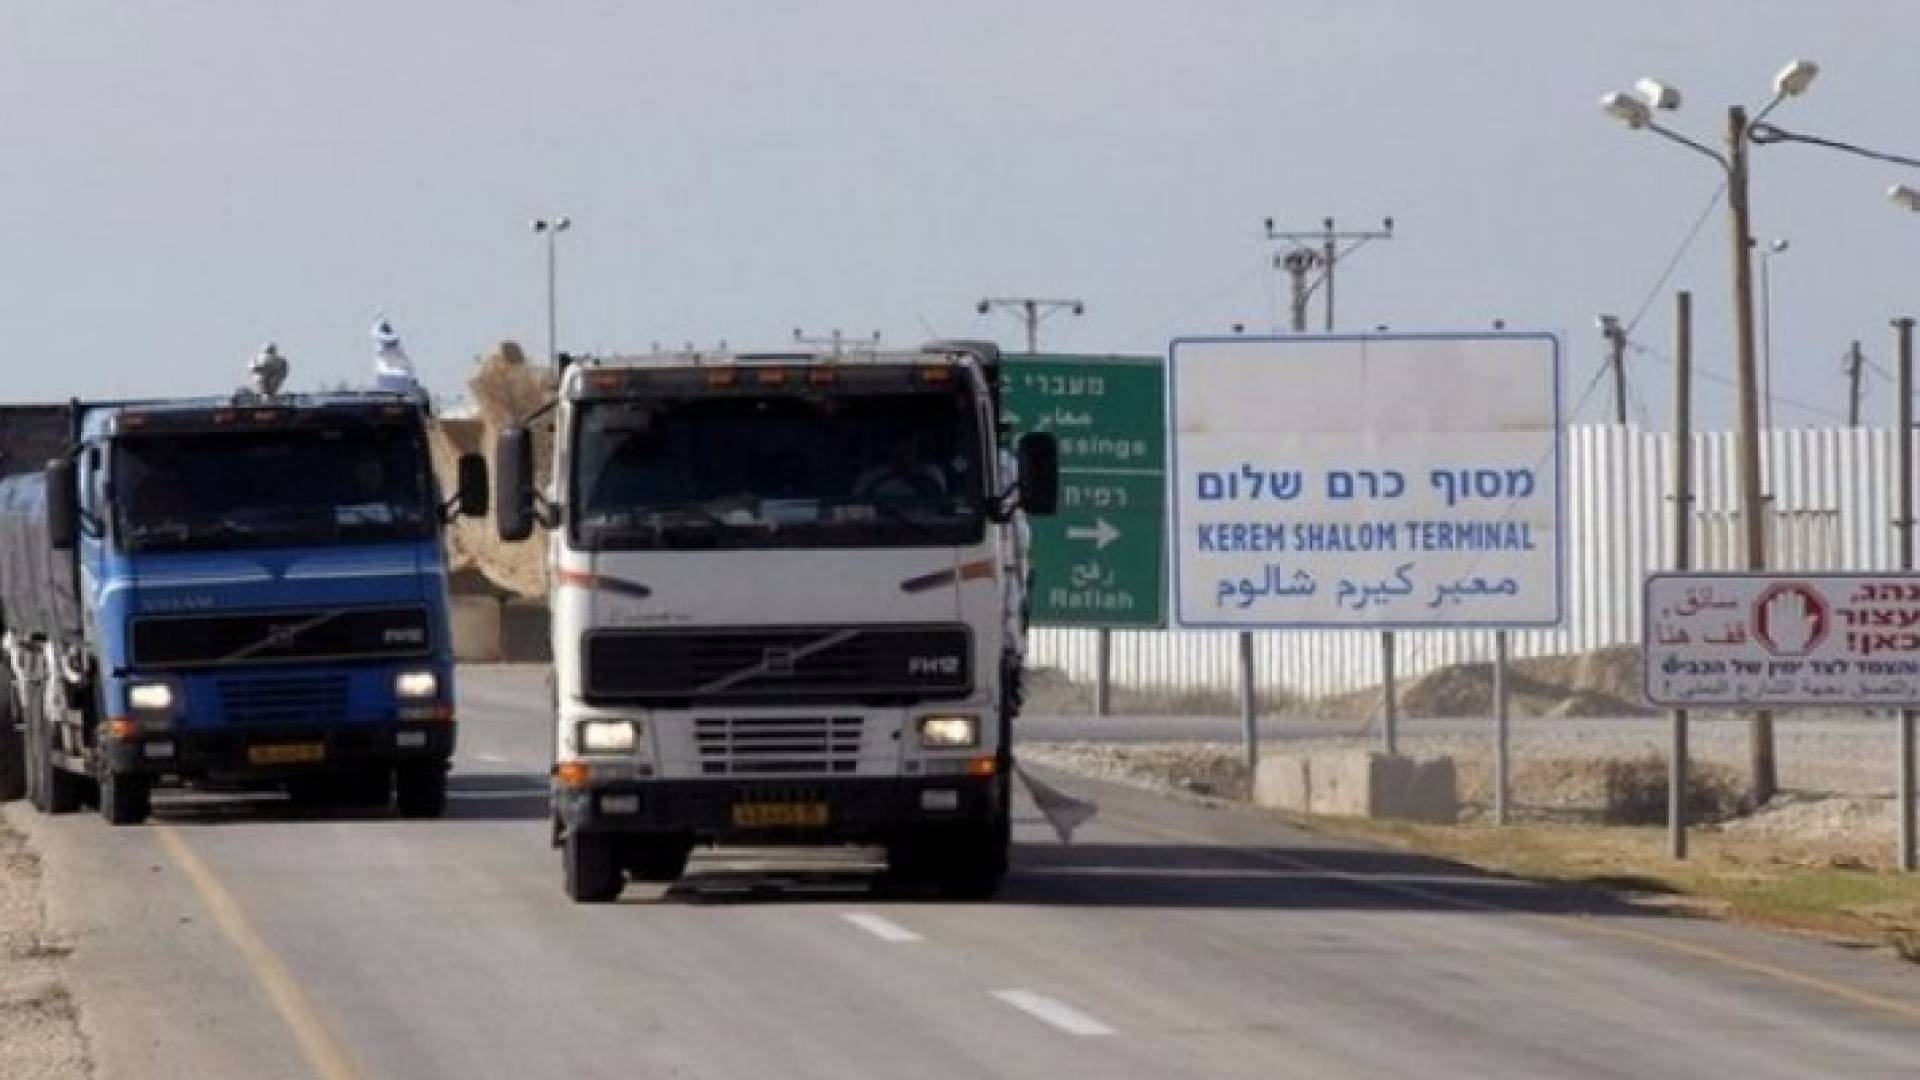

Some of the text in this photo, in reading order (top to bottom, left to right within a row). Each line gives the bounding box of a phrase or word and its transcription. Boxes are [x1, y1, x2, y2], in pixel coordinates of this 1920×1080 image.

[1197, 463, 1535, 507] מסוף כרם שלום
[1198, 520, 1536, 552] KEREM SHALOM TERMINAL
[1216, 561, 1520, 611] معبر كيرم شالوم
[1835, 608, 1920, 630] עצור
